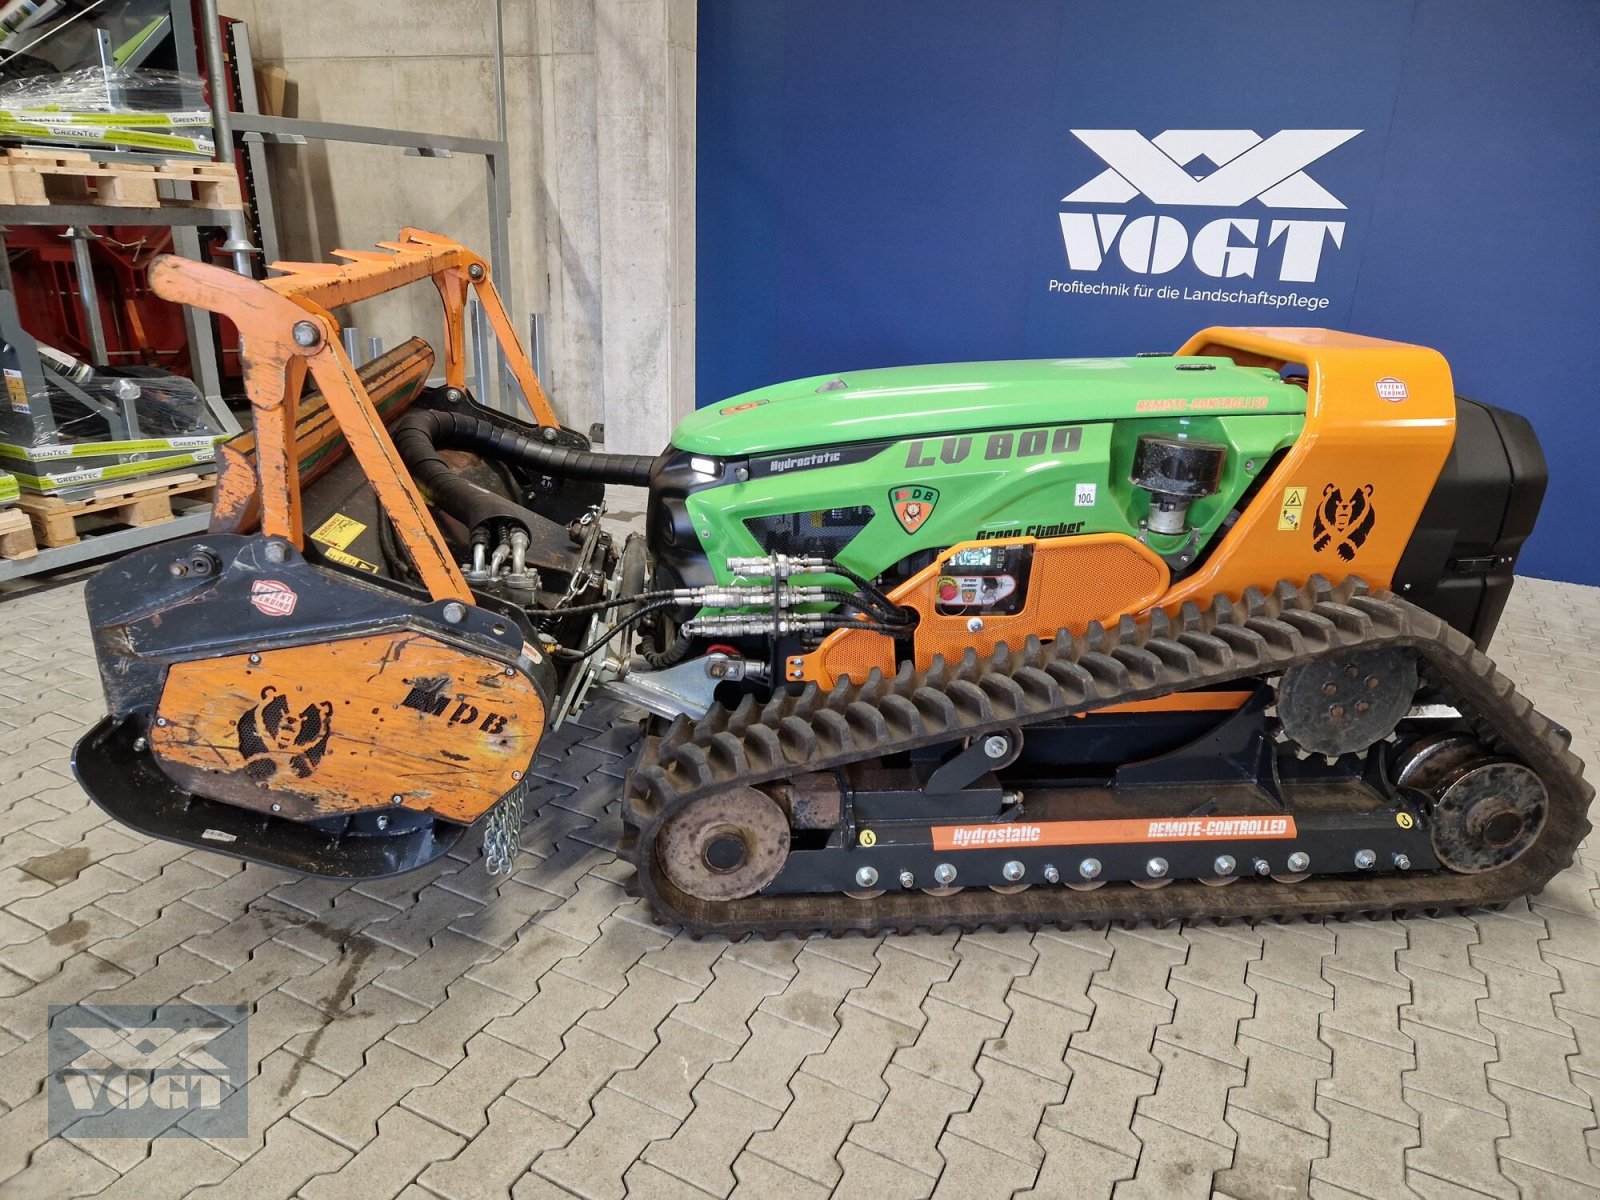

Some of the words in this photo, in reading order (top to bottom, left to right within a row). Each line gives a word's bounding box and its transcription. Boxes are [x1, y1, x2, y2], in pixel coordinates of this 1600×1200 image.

[1059, 212, 1346, 282] VOGT
[1049, 279, 1130, 297] Profitechnik
[1133, 284, 1154, 298] für
[1157, 285, 1180, 299] die
[1183, 287, 1330, 311] Landschaftspflege
[1136, 396, 1269, 412] REMOTE-CONTROLLED
[984, 427, 1083, 461] 800
[770, 452, 840, 472] Hydrostatic
[1026, 521, 1086, 537] Climber
[952, 826, 1041, 846] Hydrostatic
[1147, 819, 1287, 837] REMOTE-CONTROLLED
